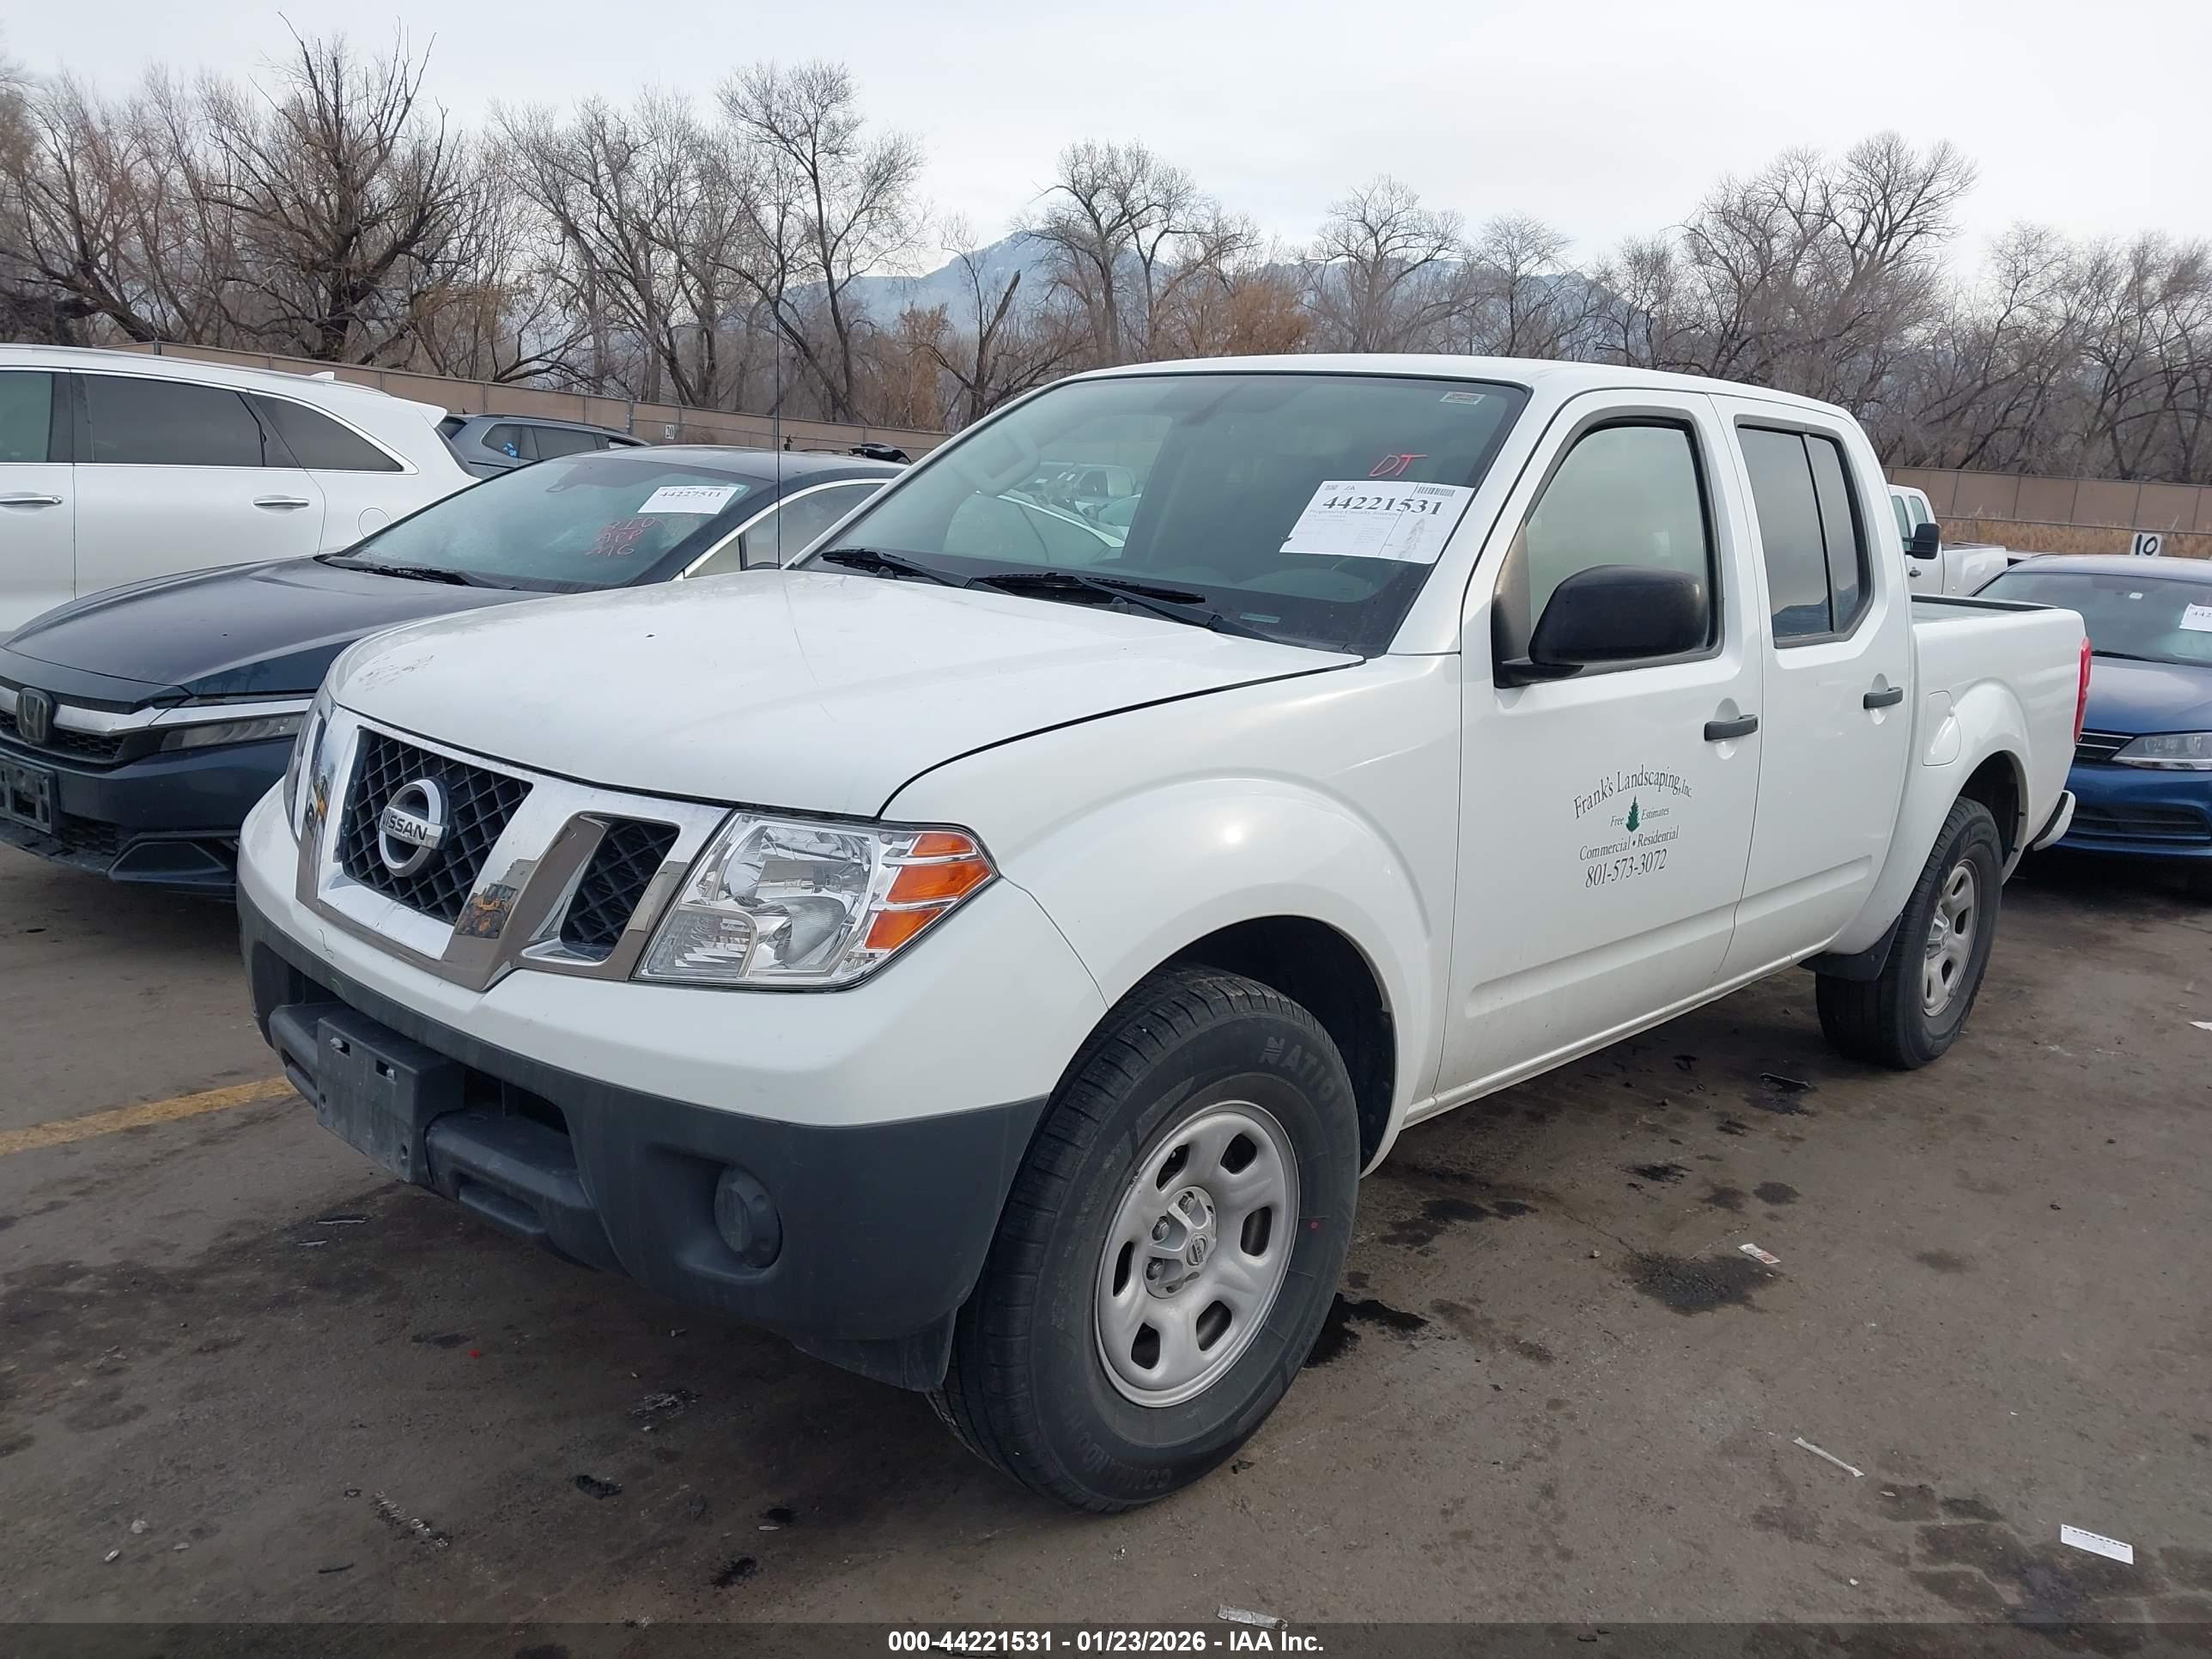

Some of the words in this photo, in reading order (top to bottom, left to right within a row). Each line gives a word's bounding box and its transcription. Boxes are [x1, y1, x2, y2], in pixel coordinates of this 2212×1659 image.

[1369, 453, 1428, 477] DT
[1322, 495, 1443, 516] 44221531
[2135, 534, 2158, 556] 10
[1573, 776, 1614, 819] Frank's
[382, 811, 428, 841] NISSAN
[1610, 815, 1625, 827] Free
[1641, 806, 1670, 821] Estimates
[1579, 836, 1631, 860] Commercial
[1638, 825, 1680, 848] Residential
[1585, 848, 1668, 889] 801-573-3072
